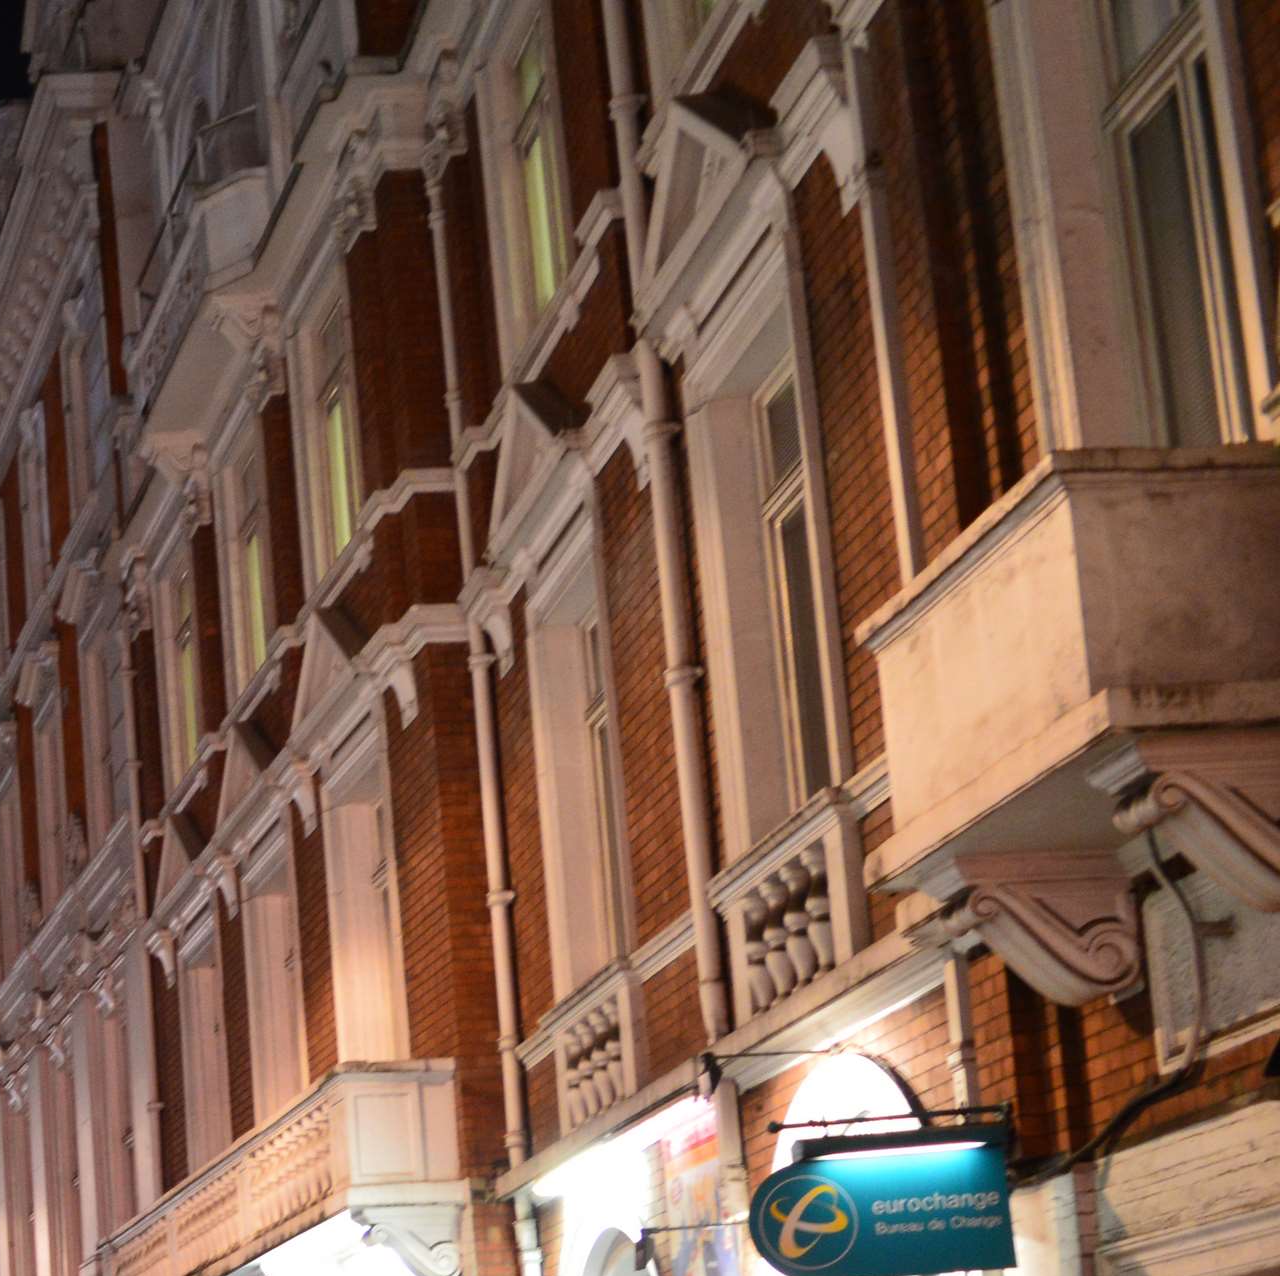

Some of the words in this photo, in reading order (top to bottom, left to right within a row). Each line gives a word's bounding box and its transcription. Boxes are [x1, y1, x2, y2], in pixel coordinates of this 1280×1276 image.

[872, 1190, 1000, 1216] eurochange
[875, 1221, 925, 1236] Bureau
[927, 1218, 946, 1231] de
[950, 1215, 1003, 1230] Change
